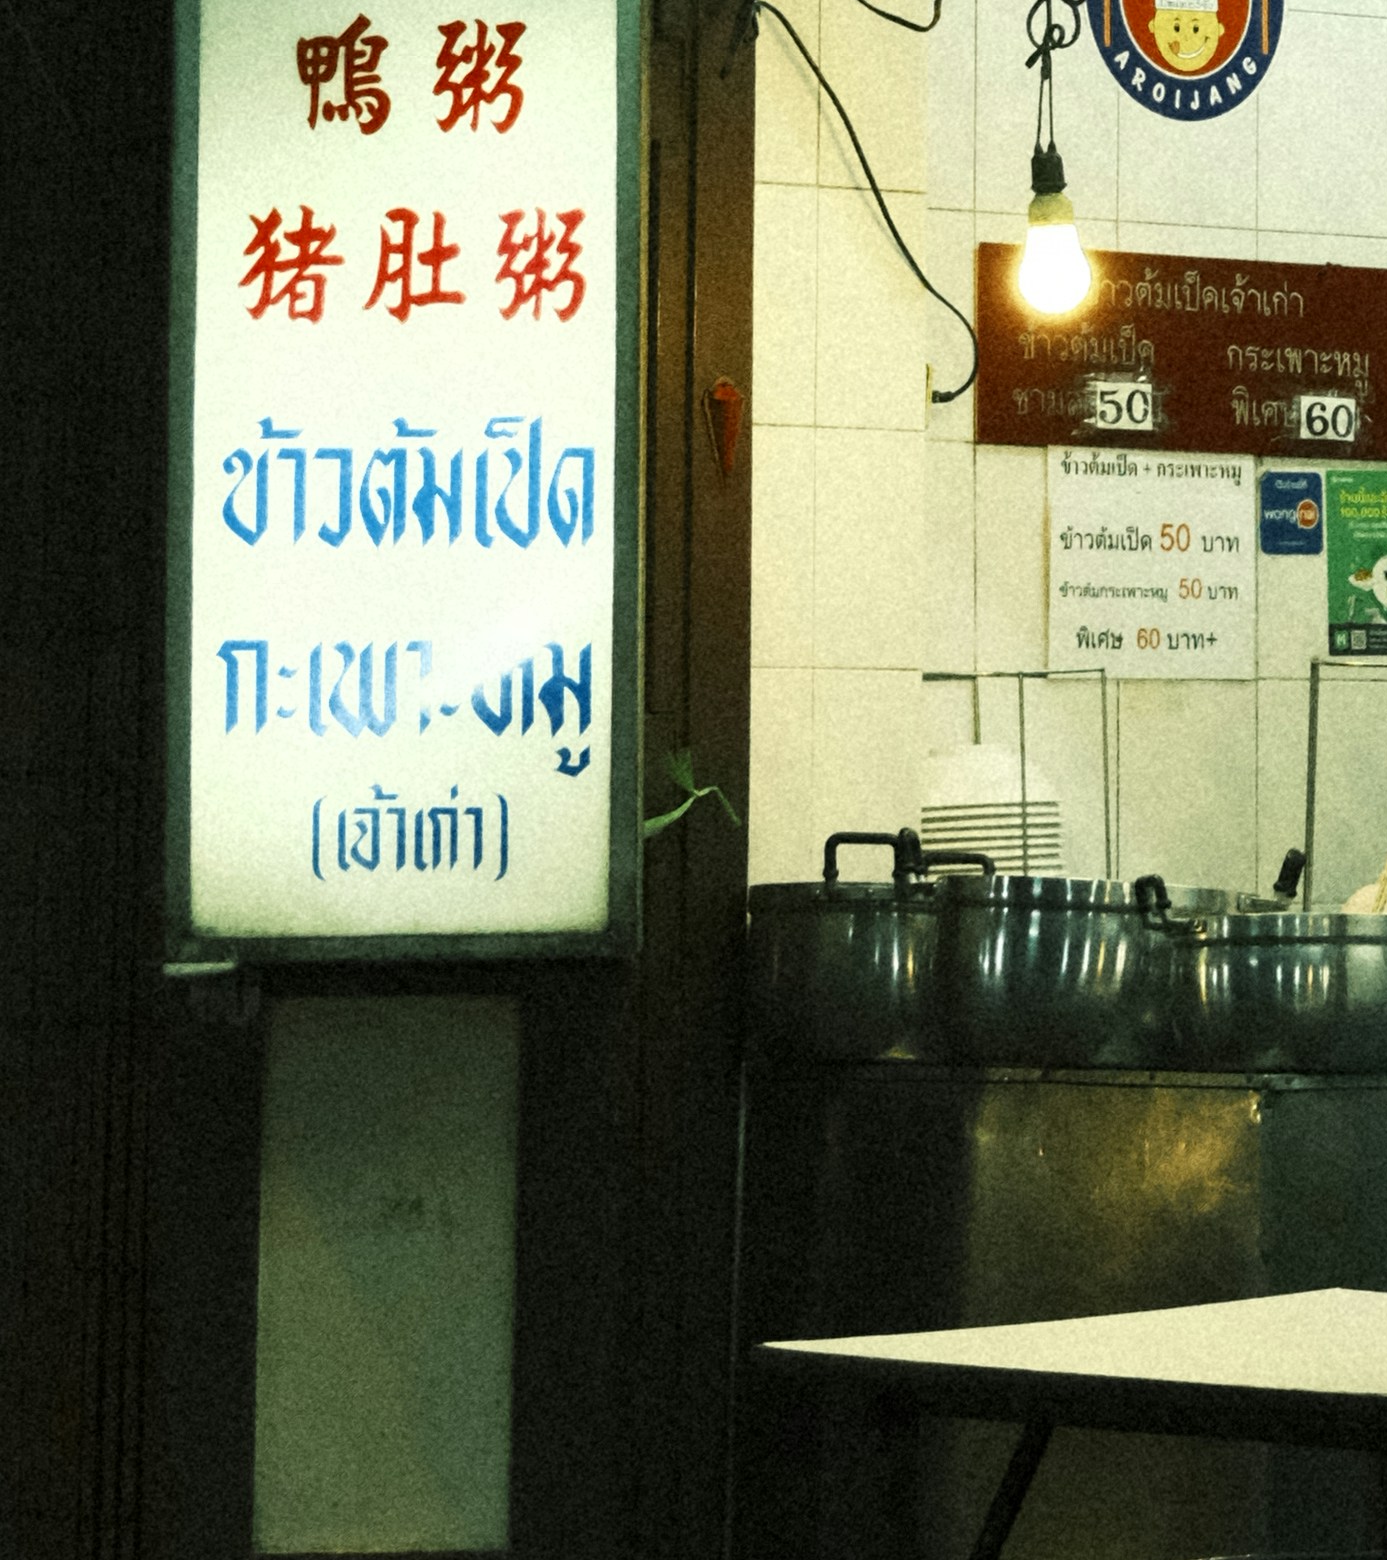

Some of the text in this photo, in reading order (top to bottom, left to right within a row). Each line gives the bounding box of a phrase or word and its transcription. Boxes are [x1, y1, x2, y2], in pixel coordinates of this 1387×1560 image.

[296, 12, 528, 137] 鴨粥
[1113, 55, 1259, 111] AROIJANG
[1226, 344, 1371, 398] กระเพาะหมู
[1099, 389, 1152, 425] 50
[1305, 401, 1355, 440] 60
[222, 414, 596, 550] ข้าวต้มเป็ด
[1157, 462, 1243, 487] กระเพาะหมู
[1160, 523, 1190, 552] 50
[1202, 533, 1239, 553] บาท
[1178, 577, 1202, 600] 50
[1208, 584, 1238, 600] บาท
[1076, 625, 1123, 649] พิเศษ
[1136, 627, 1160, 649] 60
[312, 782, 509, 883] (เจ้าเก่า)
